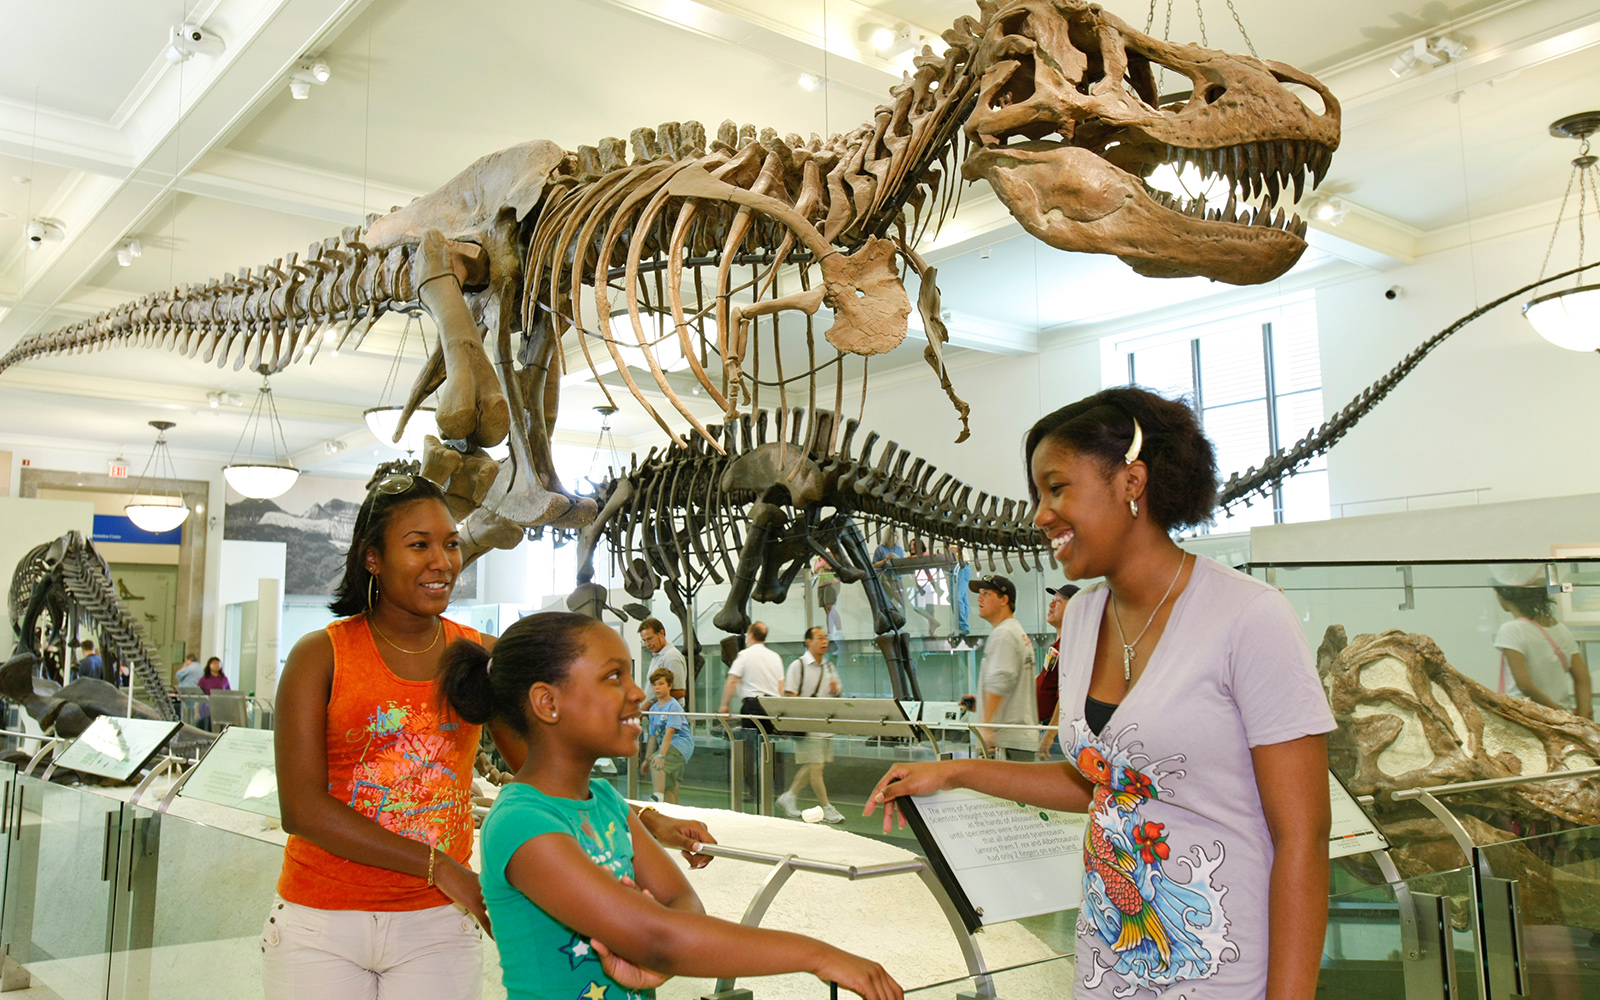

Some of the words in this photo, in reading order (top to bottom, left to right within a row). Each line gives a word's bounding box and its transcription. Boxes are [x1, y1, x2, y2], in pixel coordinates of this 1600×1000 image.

[112, 465, 127, 477] EXIT
[927, 807, 940, 815] The
[964, 801, 1006, 812] Tyrannosaurus
[929, 815, 958, 824] Scientists
[958, 812, 983, 821] thought
[996, 808, 1028, 817] tyrannosaur
[1011, 814, 1039, 823] Allosaurus
[949, 831, 964, 840] until
[964, 828, 997, 838] specimens
[1045, 818, 1062, 827] which
[1062, 817, 1085, 826] showed
[1003, 832, 1030, 842] advanced
[1029, 828, 1065, 839] tyrannosaurs
[974, 846, 999, 855] (among
[1042, 835, 1080, 845] Albertosaurus)
[1018, 849, 1039, 858] fingers
